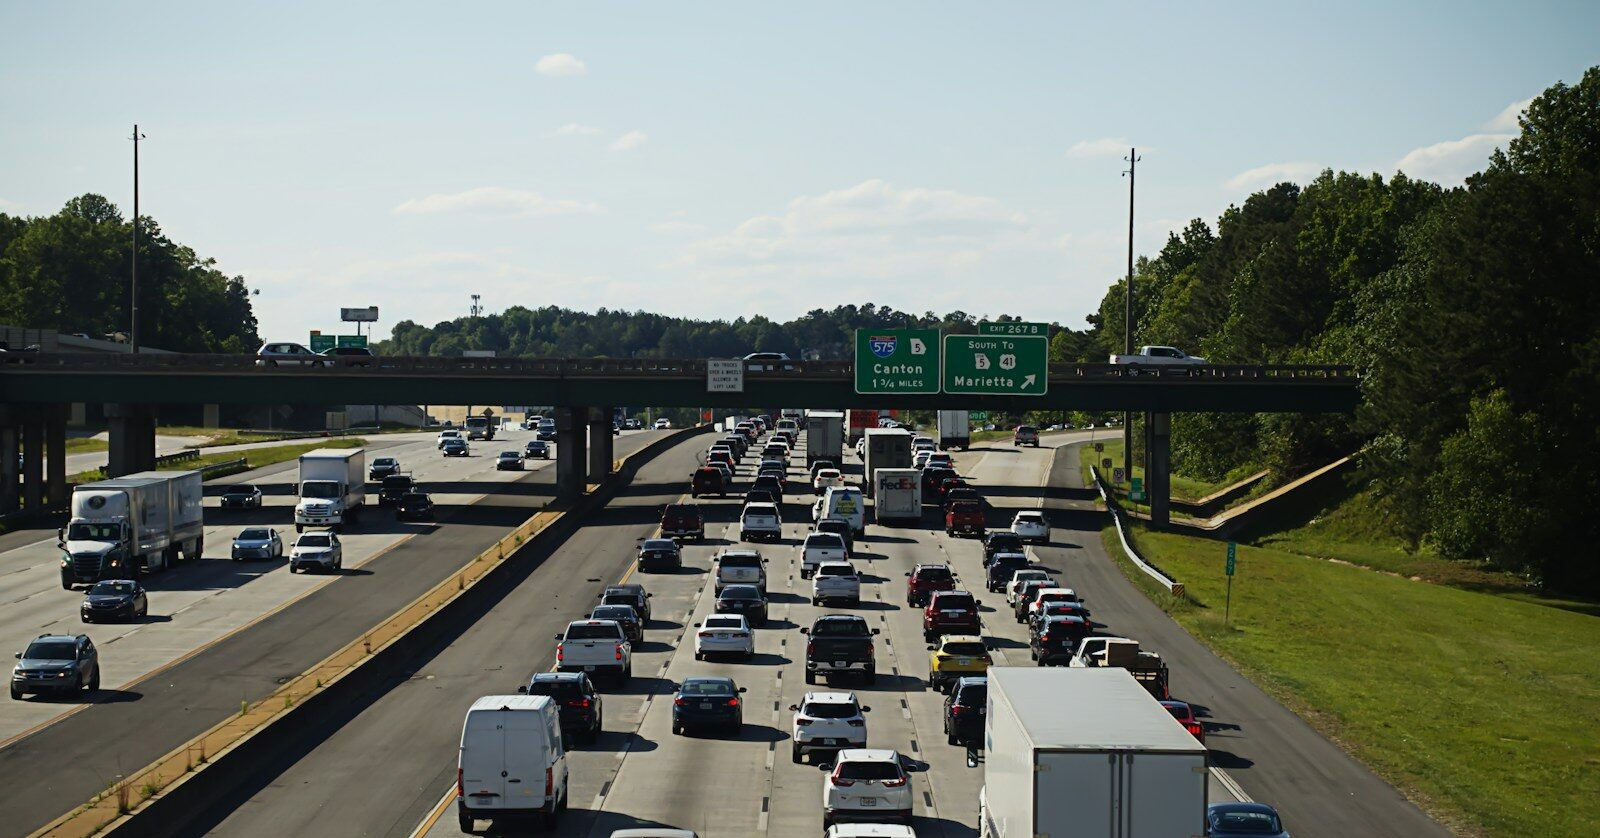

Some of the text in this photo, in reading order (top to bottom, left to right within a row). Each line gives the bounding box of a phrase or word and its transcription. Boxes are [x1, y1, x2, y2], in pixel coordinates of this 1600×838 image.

[1008, 325, 1028, 334] 267
[1031, 326, 1038, 334] B
[874, 342, 895, 352] 575
[915, 343, 921, 353] 5
[979, 358, 985, 367] 5
[1003, 357, 1013, 367] 41
[873, 364, 923, 374] Canton
[954, 376, 1014, 387] Marietta
[880, 478, 917, 491] FedEx
[1227, 548, 1235, 575] 267
